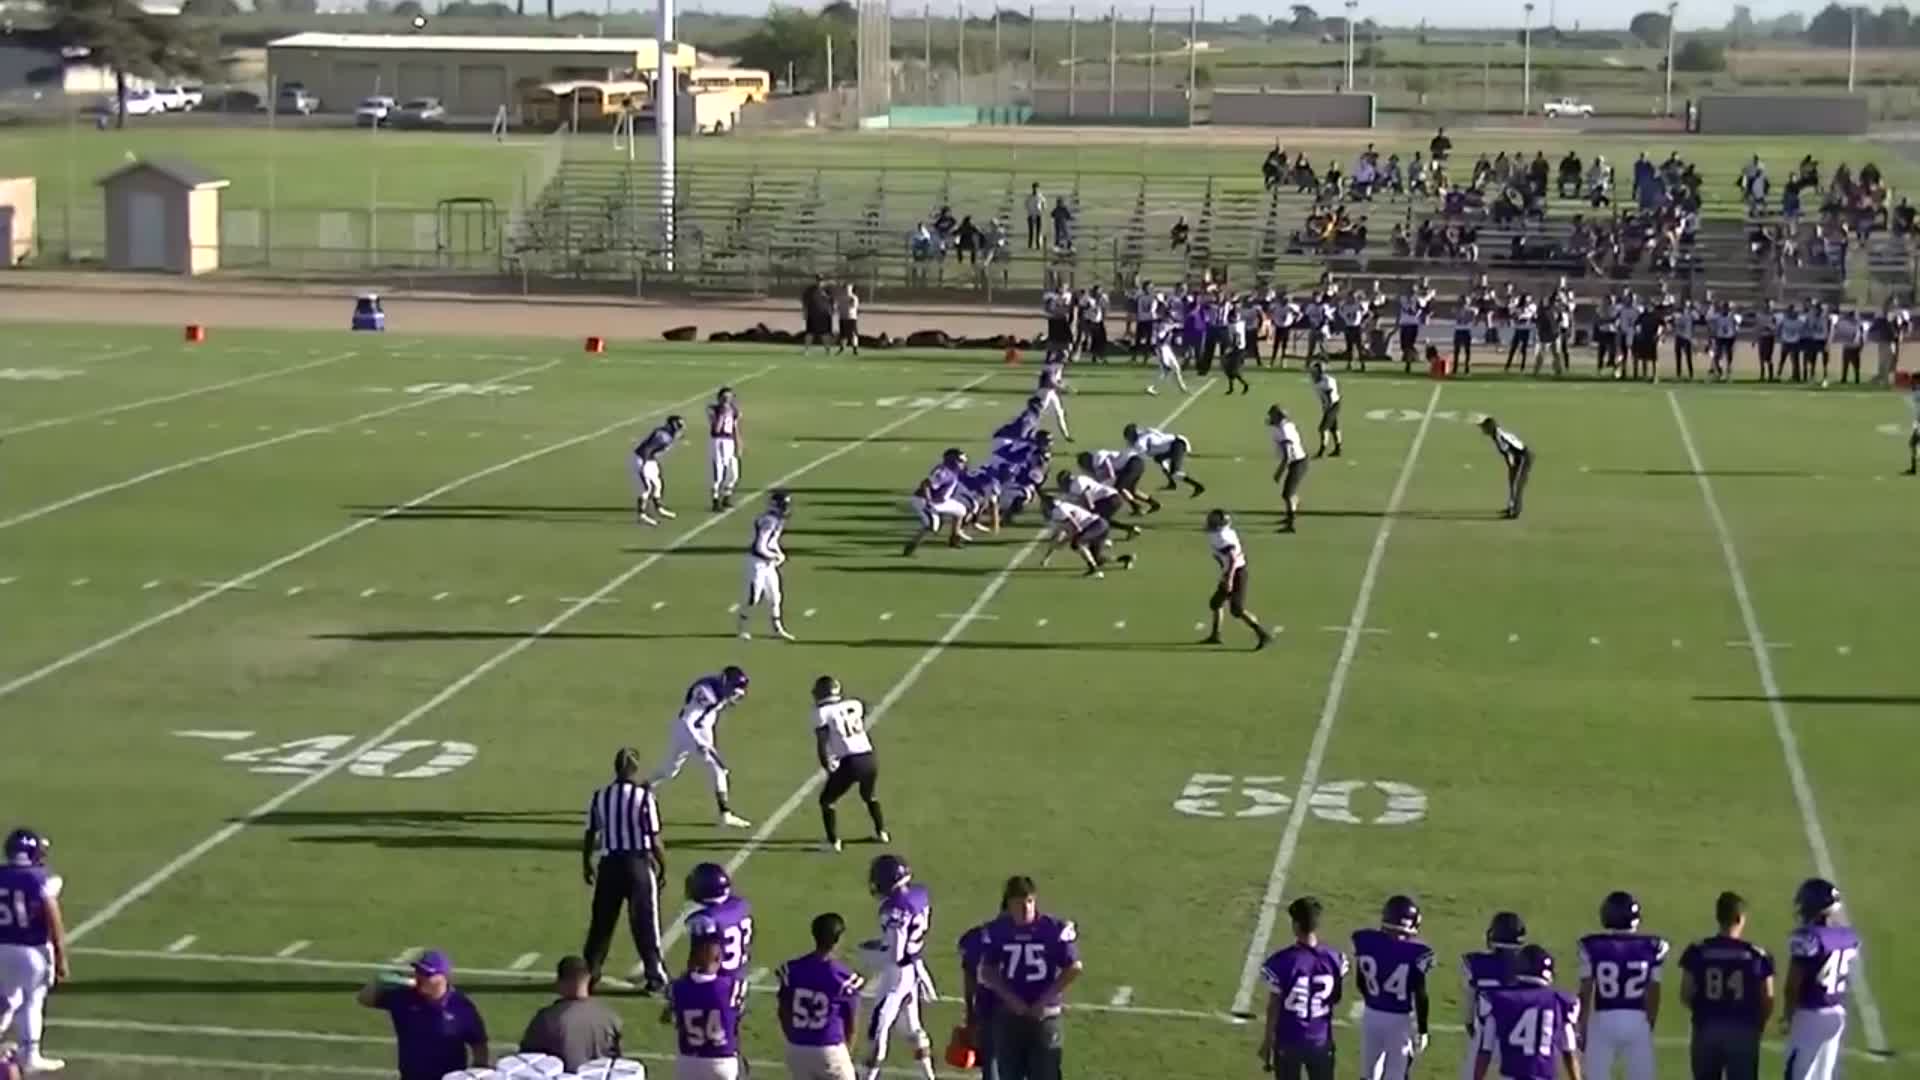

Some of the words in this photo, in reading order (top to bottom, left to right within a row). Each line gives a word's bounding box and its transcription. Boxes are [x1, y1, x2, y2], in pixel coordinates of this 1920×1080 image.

[222, 734, 478, 778] 40
[1173, 773, 1428, 823] 50
[1003, 943, 1048, 981] 75
[1358, 955, 1410, 1001] 84
[1596, 961, 1648, 998] 82
[1284, 974, 1334, 1018] 42
[1705, 967, 1744, 1000] 84
[683, 1009, 728, 1047] 54
[791, 988, 829, 1029] 53
[1508, 1008, 1554, 1056] 41
